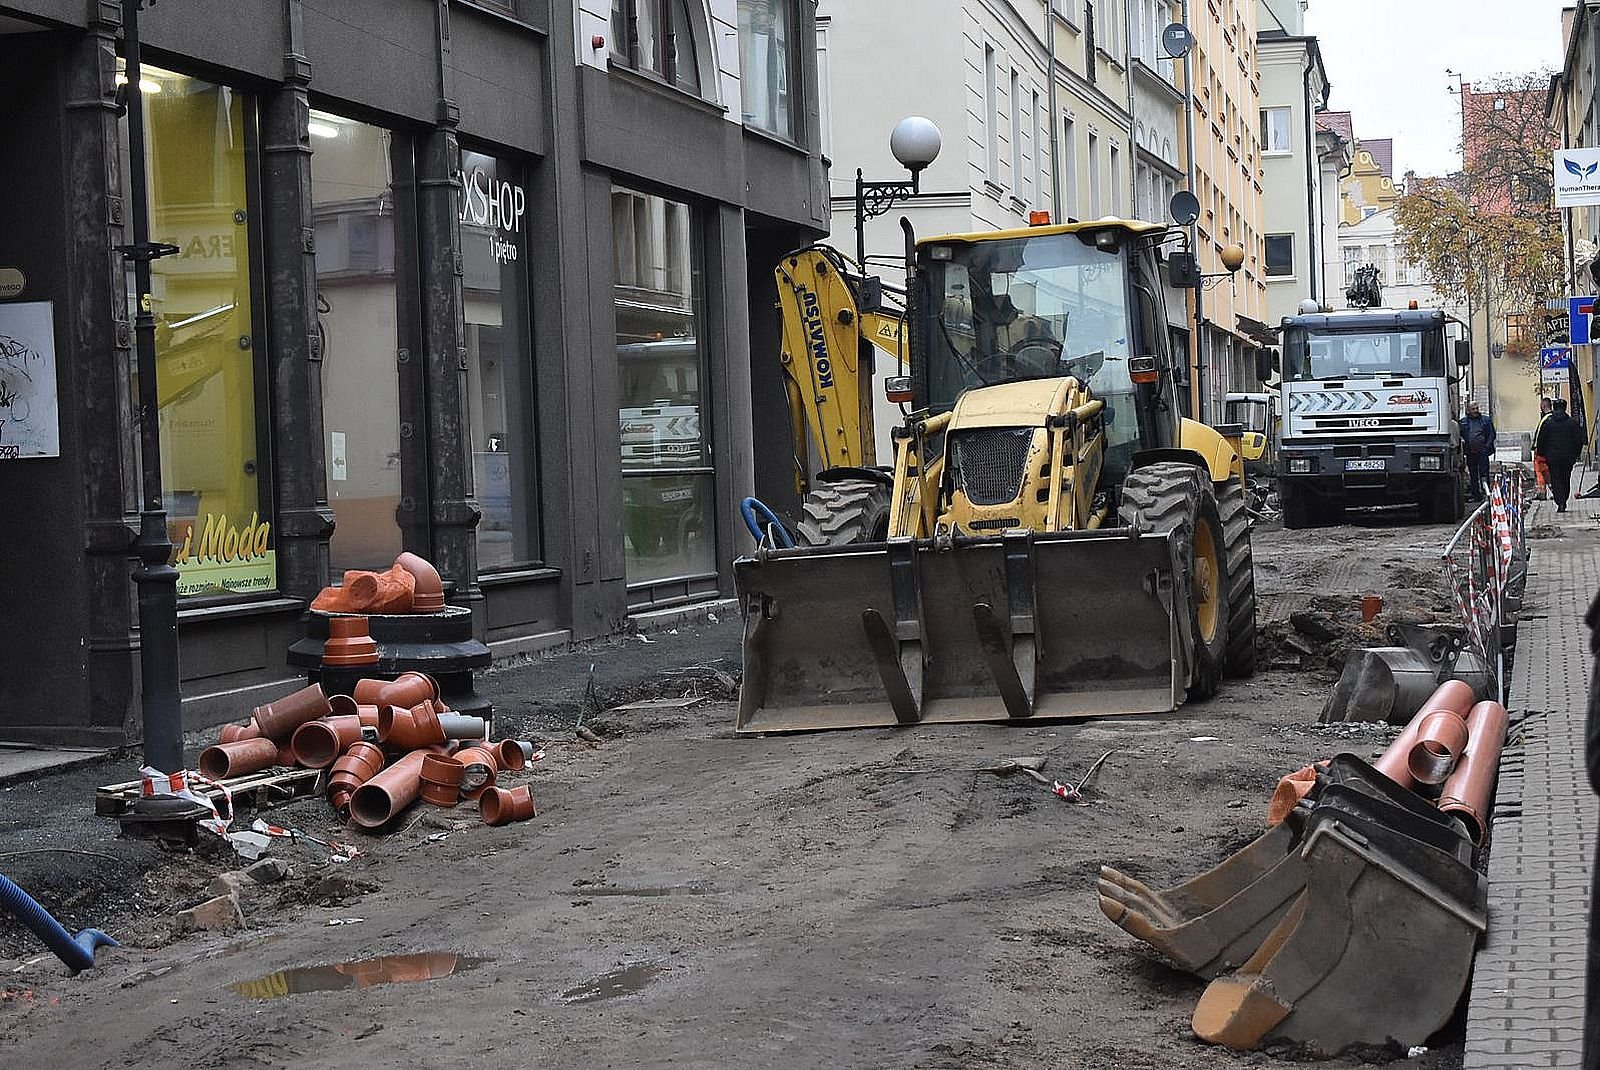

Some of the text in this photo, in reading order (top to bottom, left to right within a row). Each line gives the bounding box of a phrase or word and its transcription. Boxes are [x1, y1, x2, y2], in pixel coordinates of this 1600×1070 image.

[458, 167, 525, 233] XSHOP
[495, 237, 517, 265] piętro
[803, 292, 834, 390] KOMATSU
[1348, 419, 1380, 428] IVECO
[198, 511, 270, 564] Moda
[221, 577, 251, 589] Najnowsze
[253, 574, 271, 588] trendy
